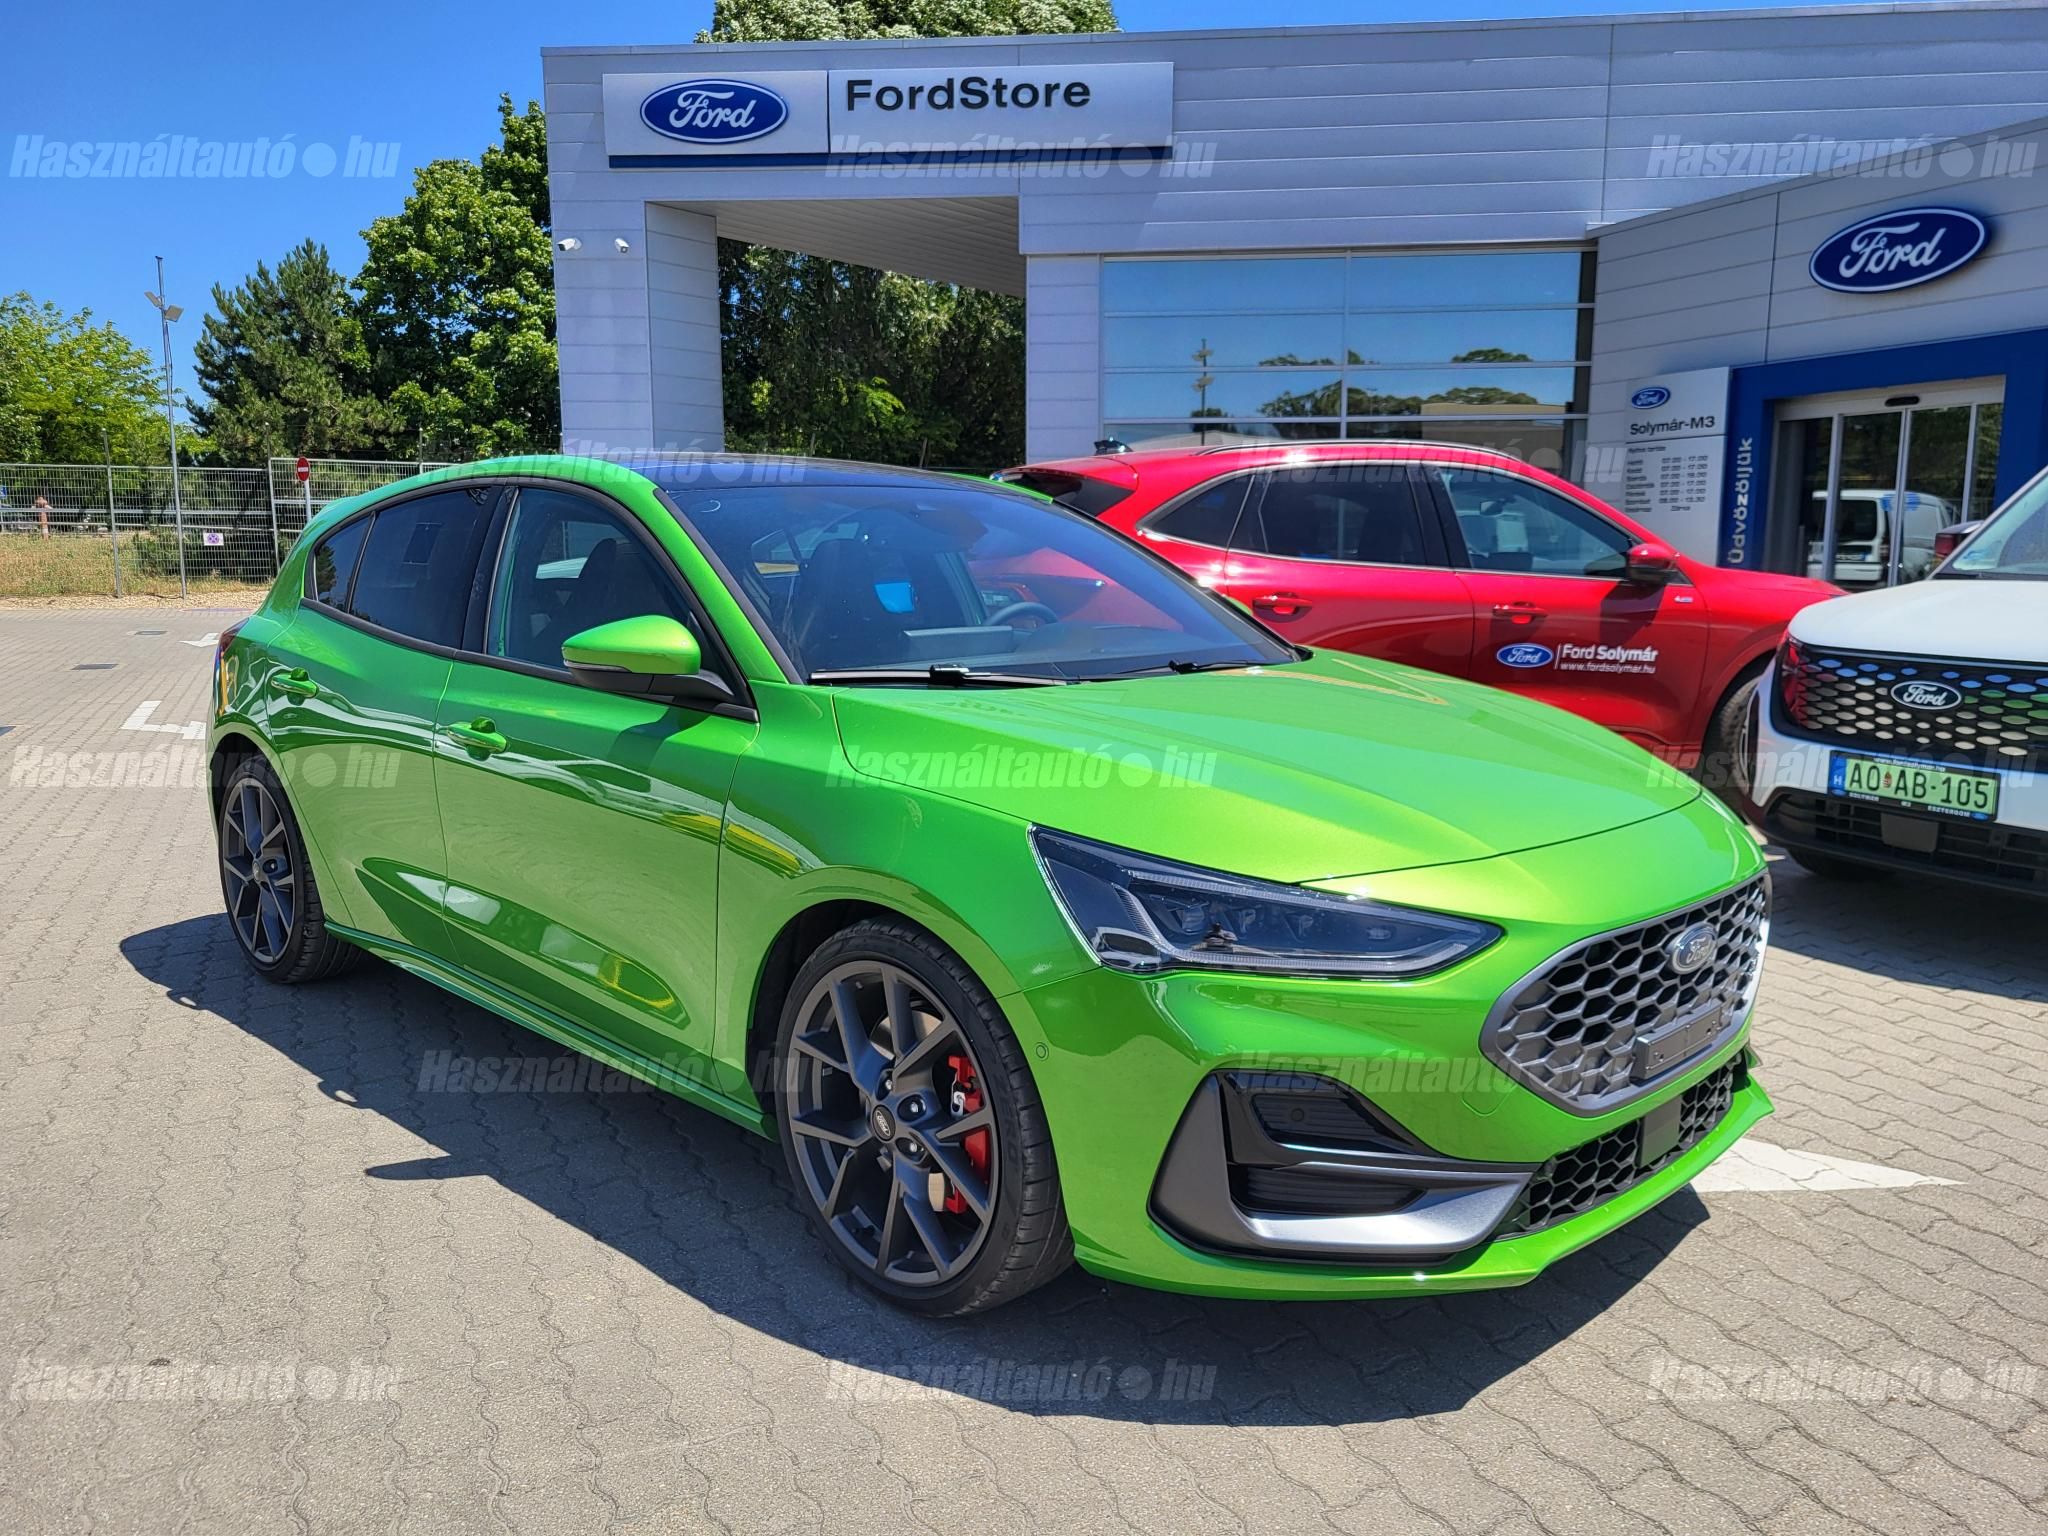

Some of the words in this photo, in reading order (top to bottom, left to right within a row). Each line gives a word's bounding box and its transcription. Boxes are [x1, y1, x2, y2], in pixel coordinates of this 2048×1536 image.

[669, 90, 757, 128] Ford
[847, 76, 1091, 111] FordStore
[1838, 221, 1947, 279] Ford
[1629, 415, 1716, 436] Solymár-M3
[1727, 437, 1753, 564] Üdvözöljük
[1507, 647, 1542, 663] Ford
[1562, 643, 1596, 659] Ford
[1596, 645, 1659, 663] Solymár
[1903, 684, 1948, 706] Ford
[1893, 769, 1990, 809] AB-105
